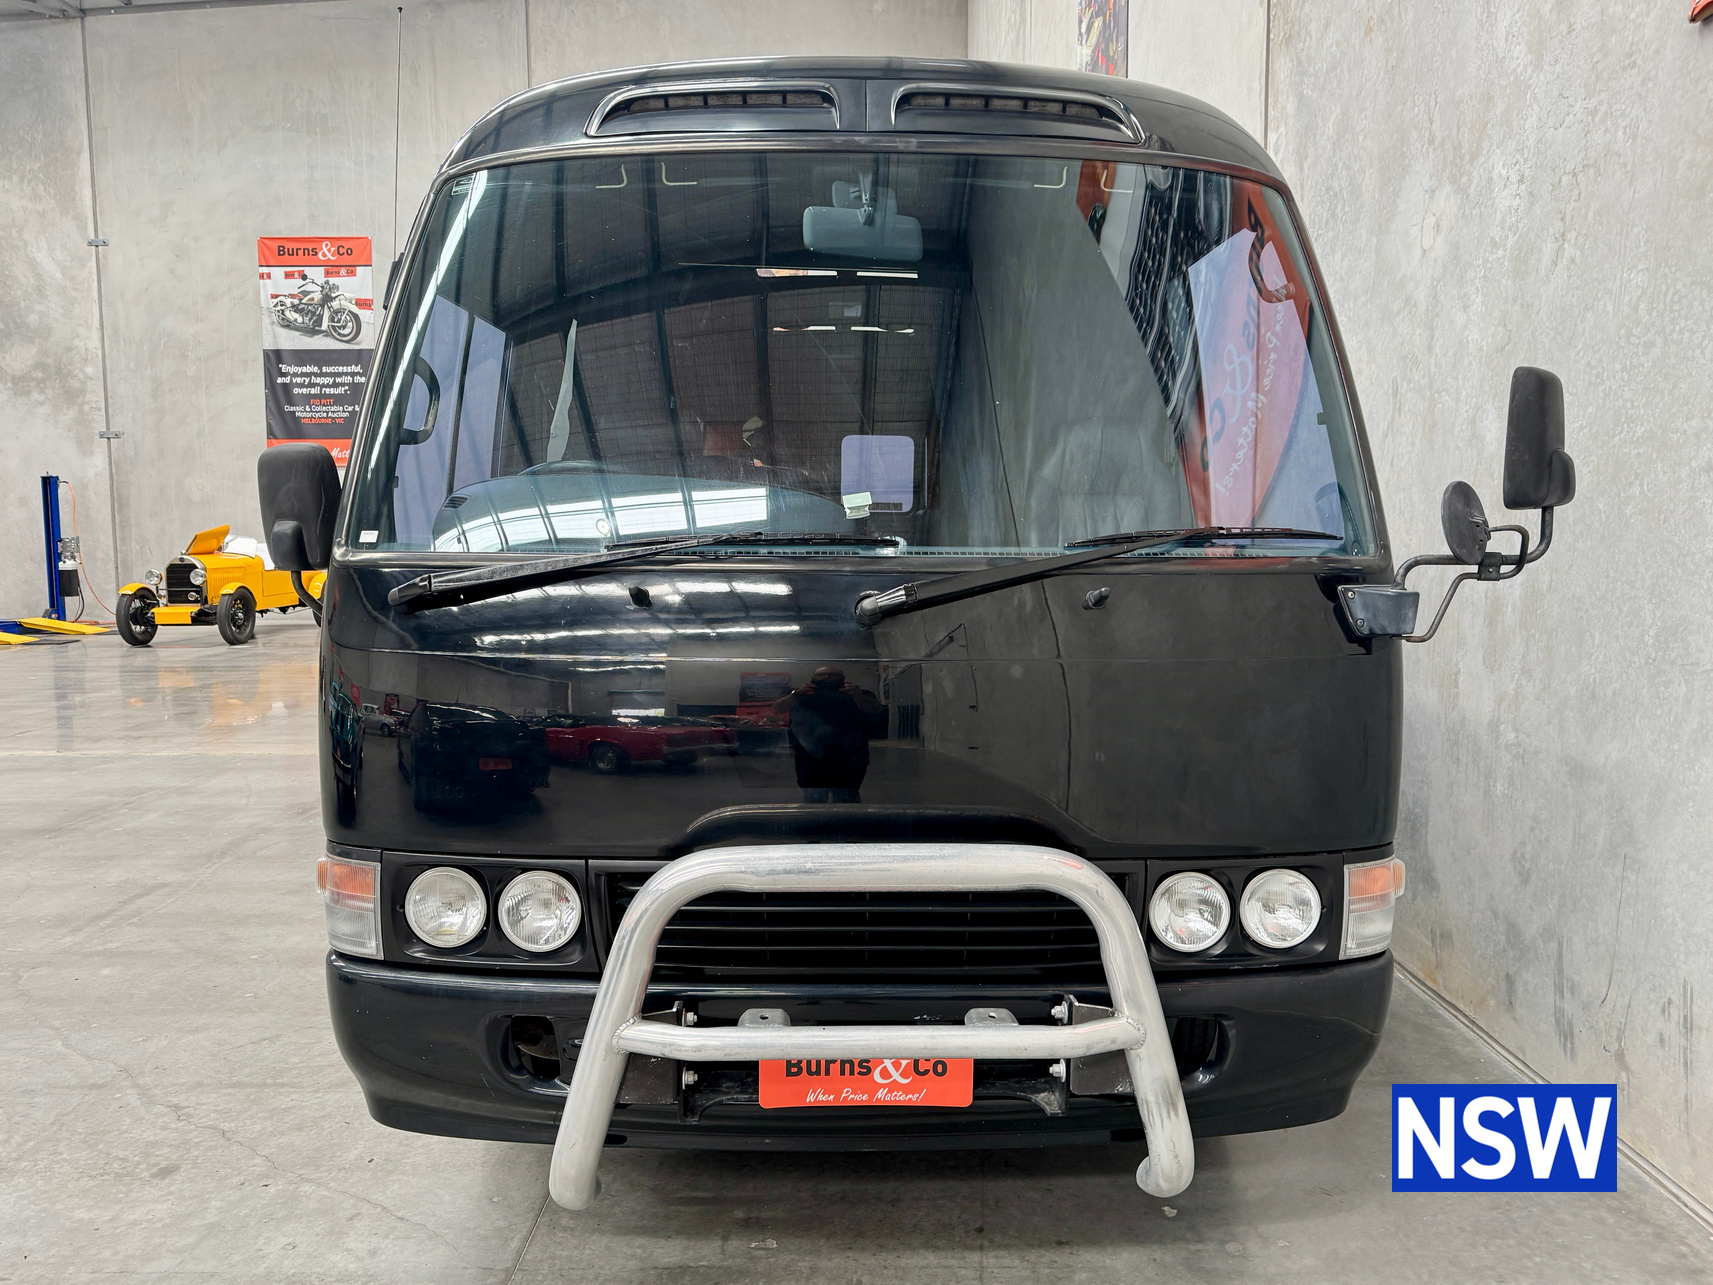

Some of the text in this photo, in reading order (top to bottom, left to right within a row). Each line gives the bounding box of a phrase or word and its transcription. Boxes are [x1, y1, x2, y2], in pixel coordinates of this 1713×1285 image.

[277, 241, 353, 260] Burns&Co
[321, 364, 363, 373] successful,
[276, 375, 366, 385] and very happy with the
[293, 386, 320, 394] overall
[806, 1088, 927, 1103] When Price Matters!
